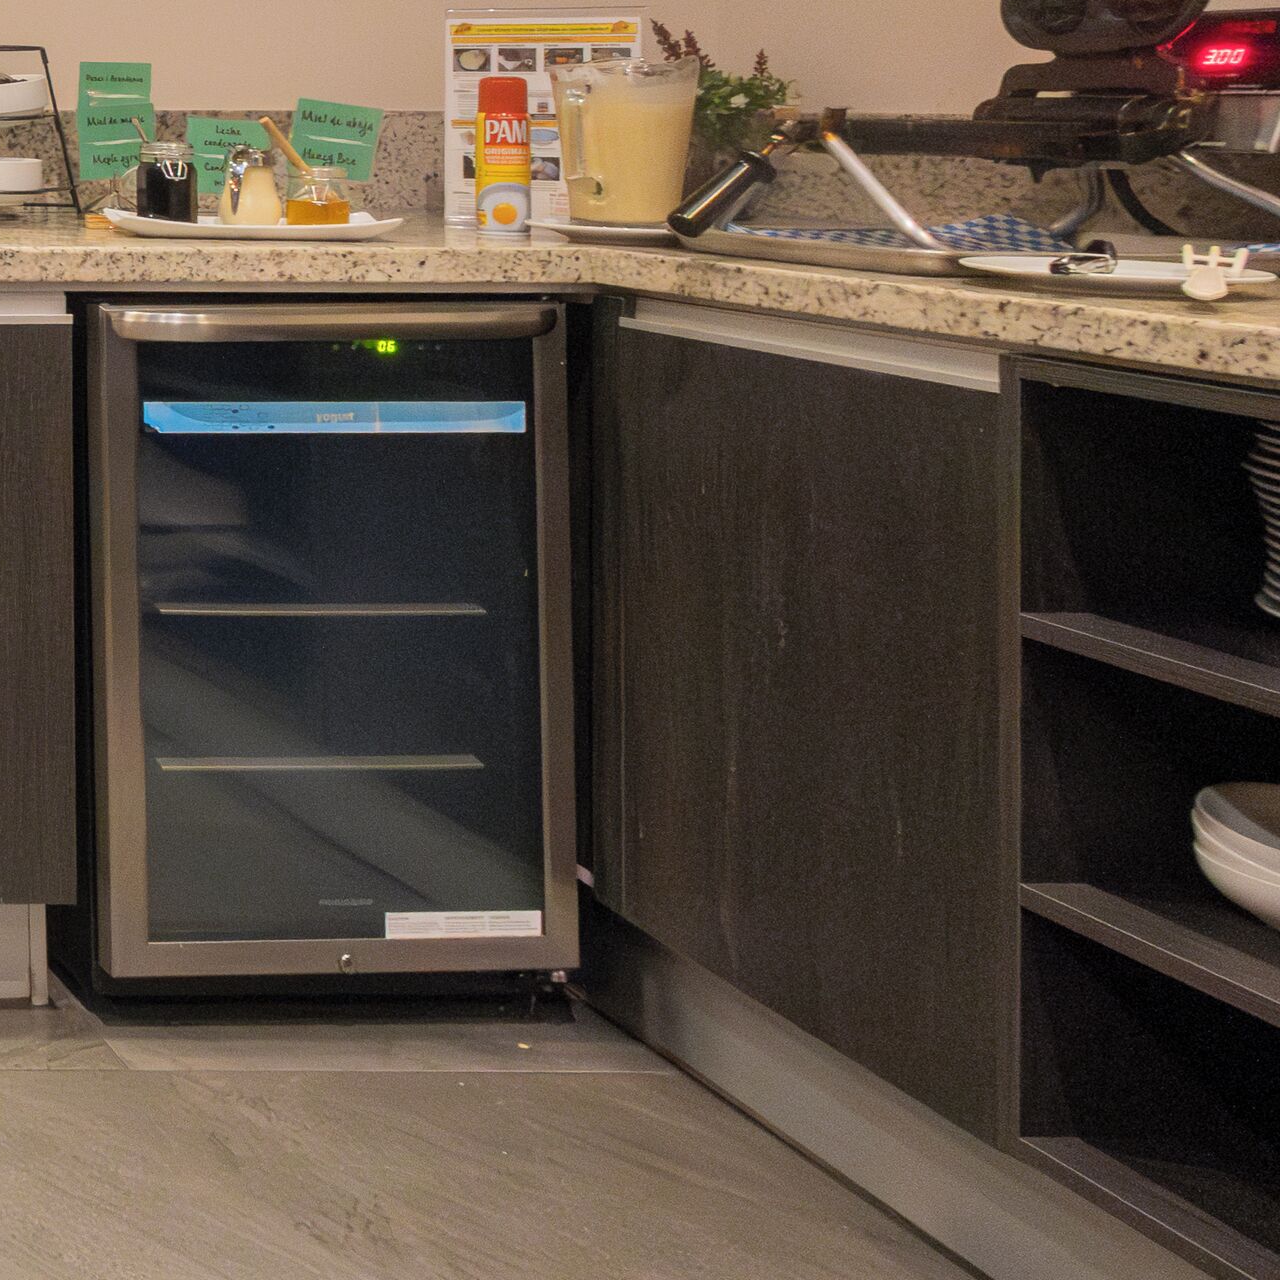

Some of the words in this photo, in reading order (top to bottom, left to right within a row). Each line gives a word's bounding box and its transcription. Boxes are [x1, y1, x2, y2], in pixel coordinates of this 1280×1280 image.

[1203, 48, 1245, 65] 300
[301, 110, 328, 124] Miel
[485, 119, 527, 144] PAM
